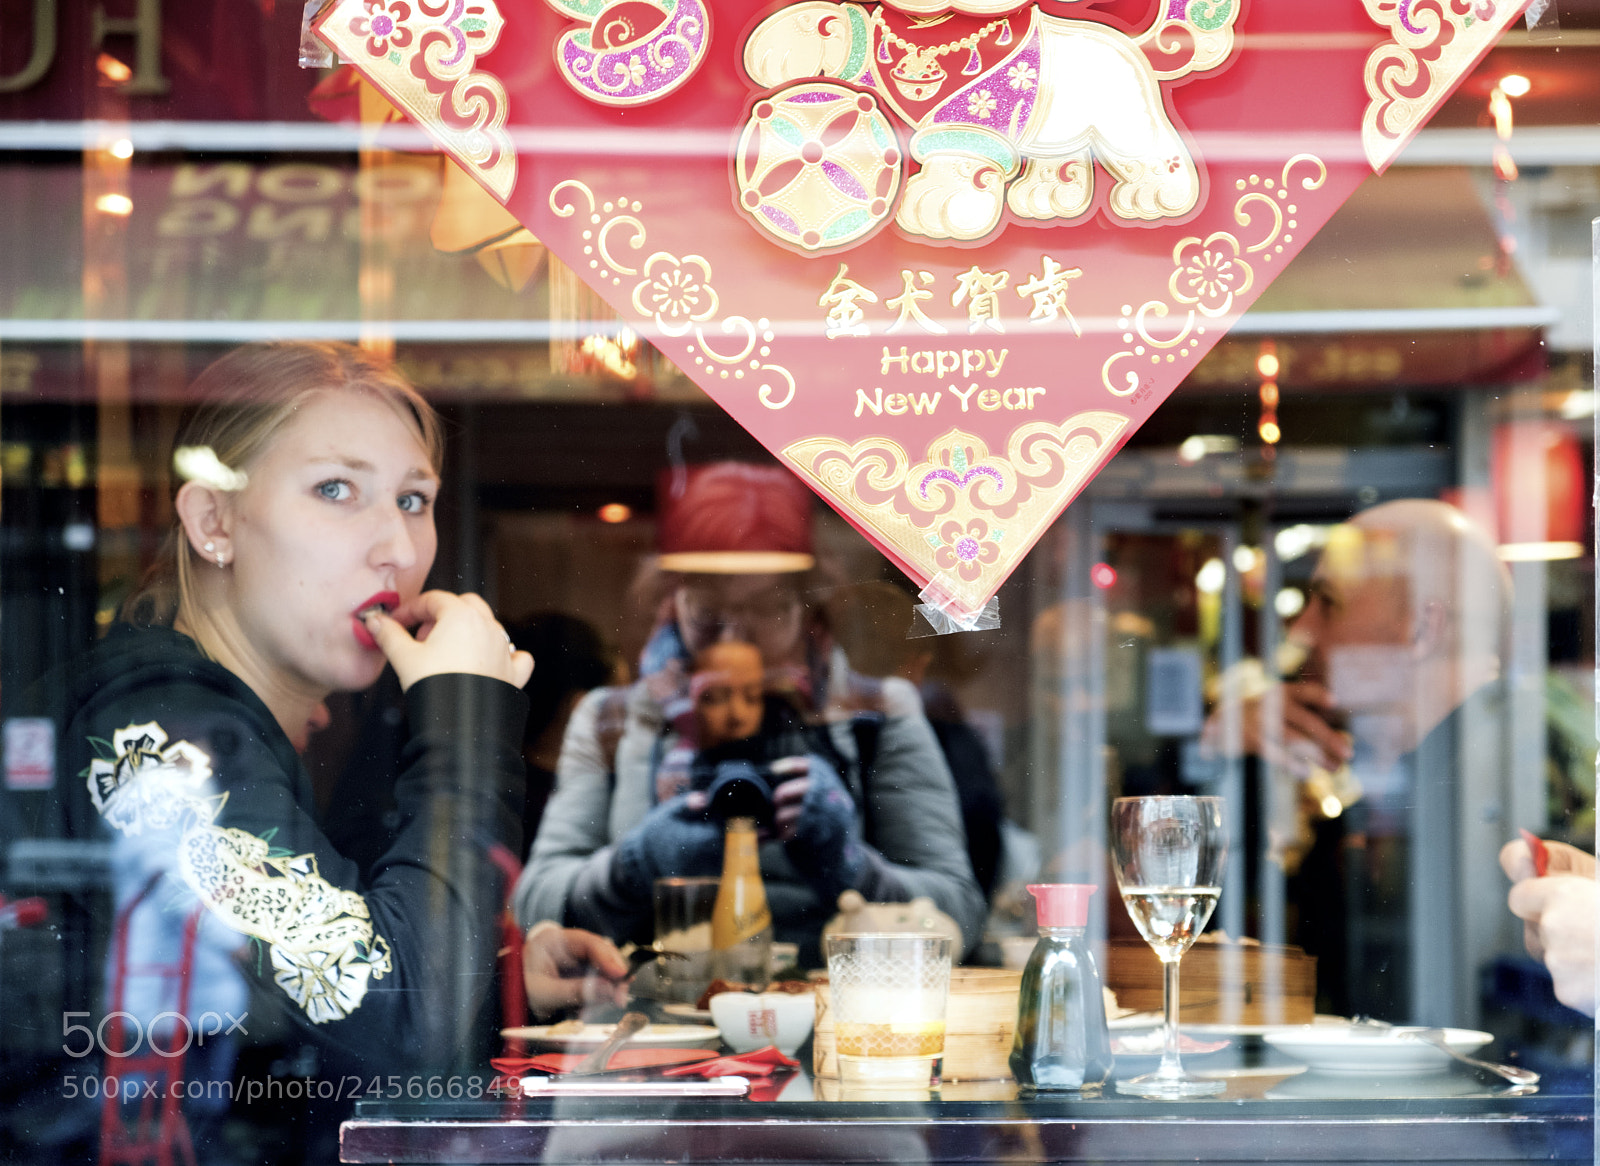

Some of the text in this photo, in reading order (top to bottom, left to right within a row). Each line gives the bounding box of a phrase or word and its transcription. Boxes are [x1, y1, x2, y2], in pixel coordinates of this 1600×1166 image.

[880, 346, 1009, 378] Happy
[854, 383, 1047, 417] New Year
